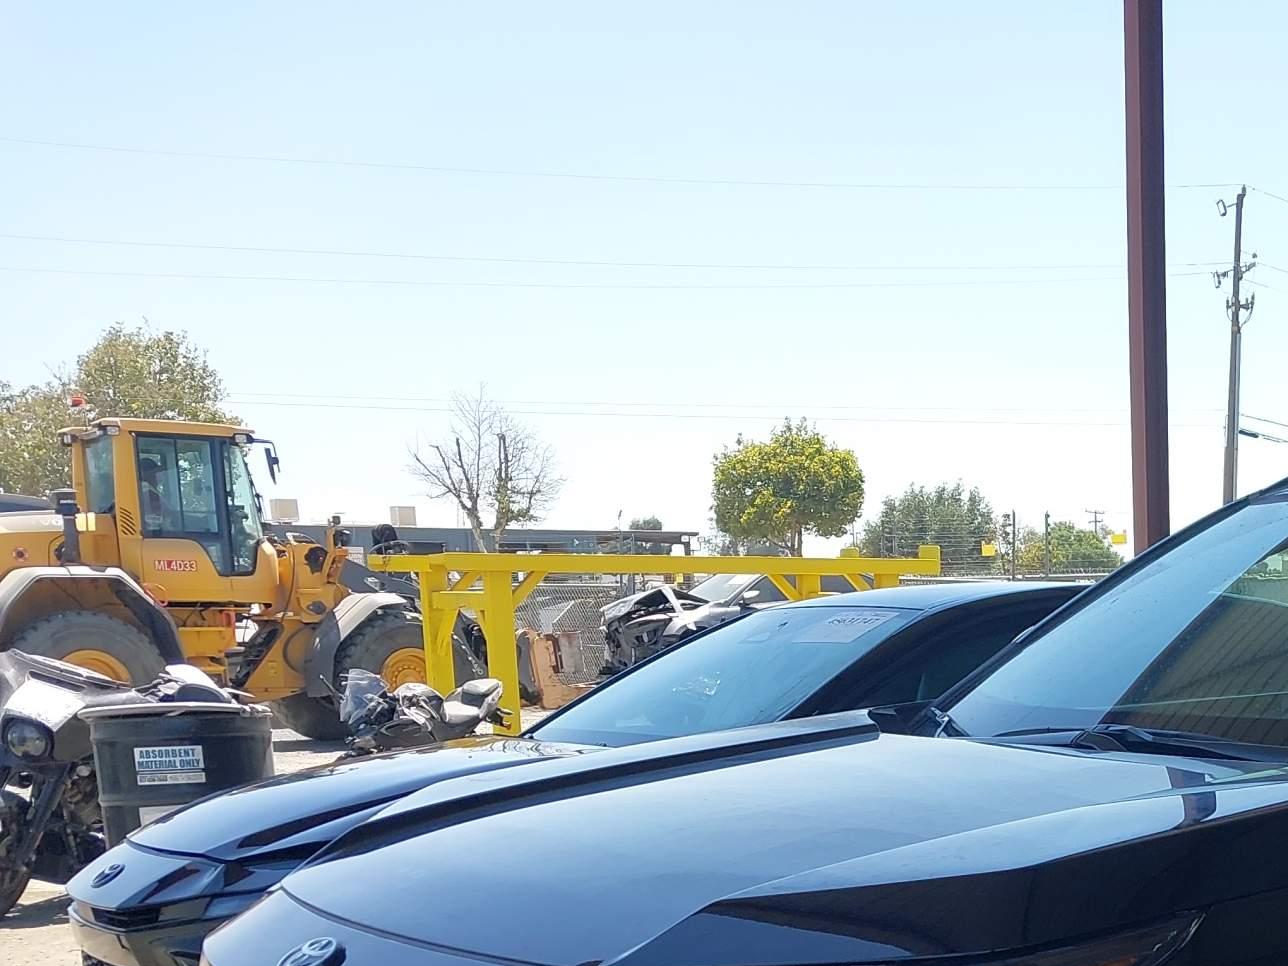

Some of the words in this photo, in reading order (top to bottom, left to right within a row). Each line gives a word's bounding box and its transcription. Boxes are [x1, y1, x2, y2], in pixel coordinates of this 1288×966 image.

[154, 560, 198, 571] ML4D33
[139, 748, 196, 760] ABSORBENT
[138, 760, 179, 770] MATERIAL
[179, 759, 201, 769] ONLY
